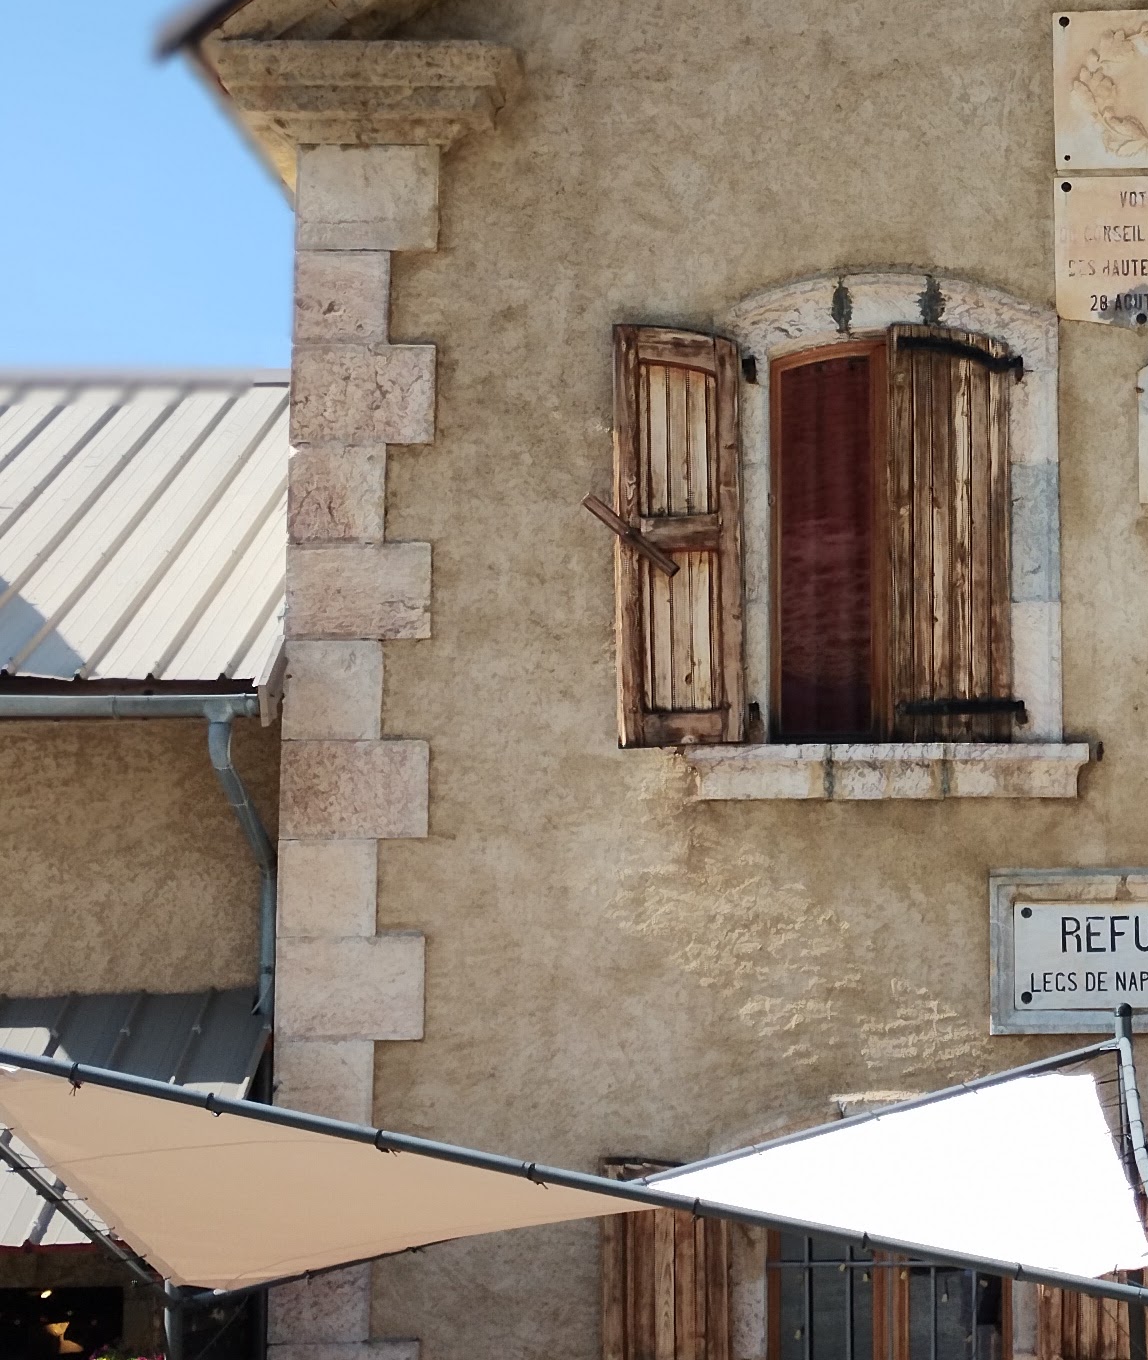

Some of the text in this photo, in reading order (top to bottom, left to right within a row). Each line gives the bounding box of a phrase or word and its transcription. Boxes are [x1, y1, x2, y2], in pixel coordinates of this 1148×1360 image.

[1090, 294, 1108, 311] 28
[1031, 972, 1078, 992] LEGS
[1085, 971, 1108, 991] DE
